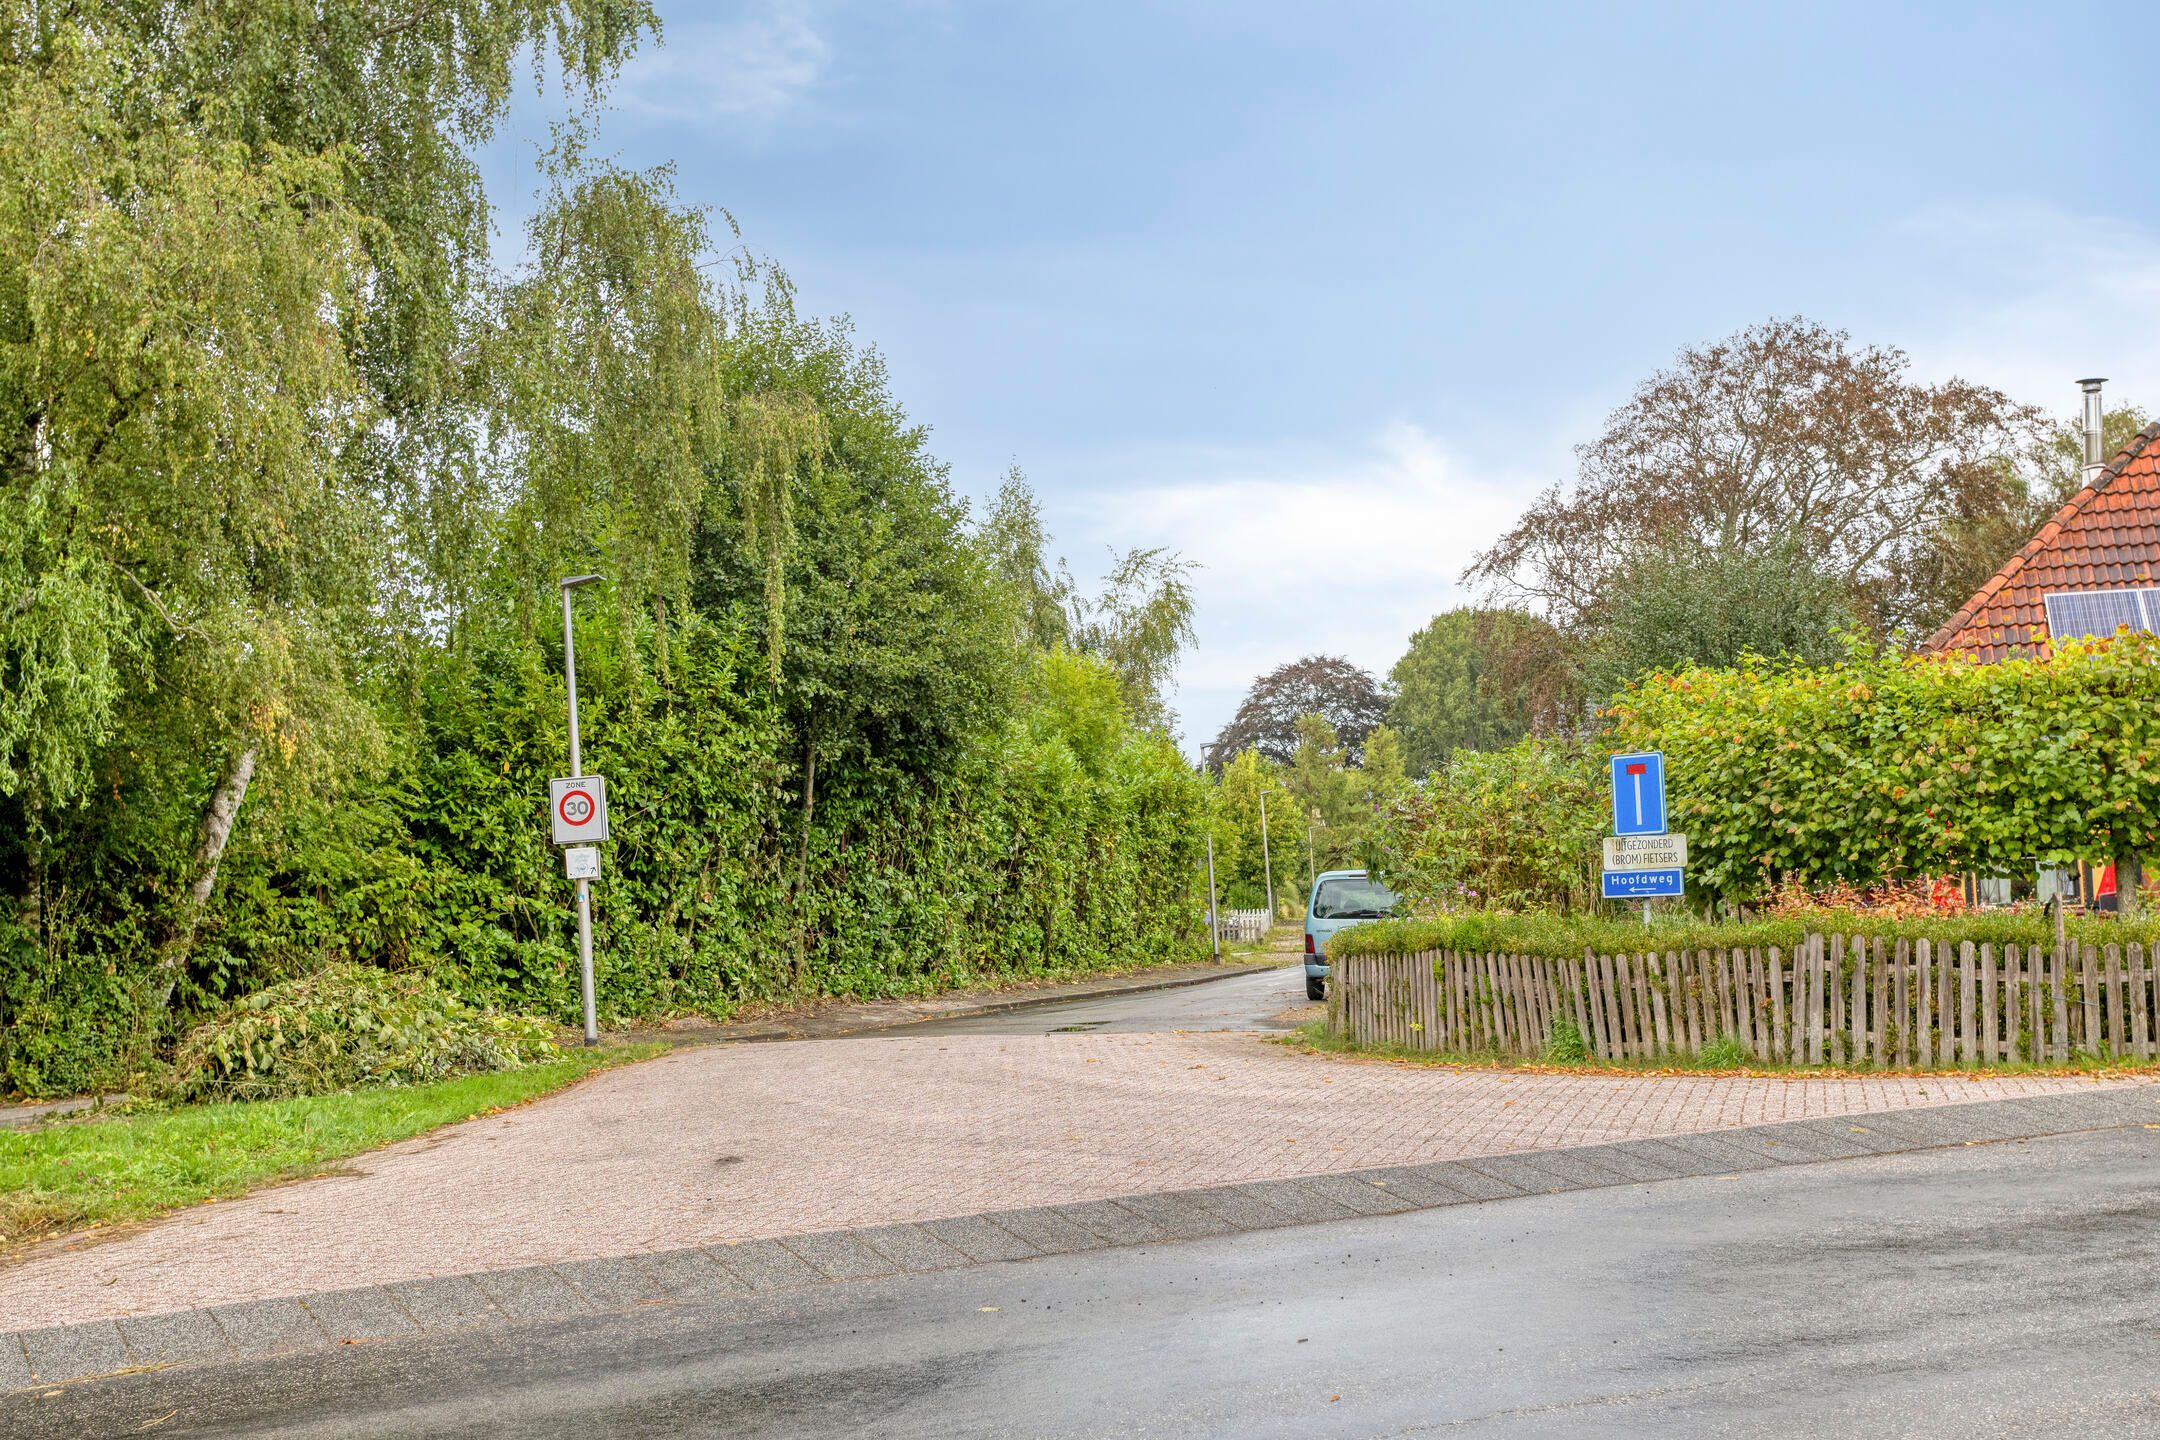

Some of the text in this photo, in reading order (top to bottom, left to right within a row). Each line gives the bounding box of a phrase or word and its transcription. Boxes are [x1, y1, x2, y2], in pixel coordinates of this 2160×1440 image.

[565, 781, 586, 789] ZONE
[566, 800, 589, 816] 30
[1615, 838, 1674, 852] UITGEZONDERD
[1611, 875, 1673, 886] Hoofdweg
